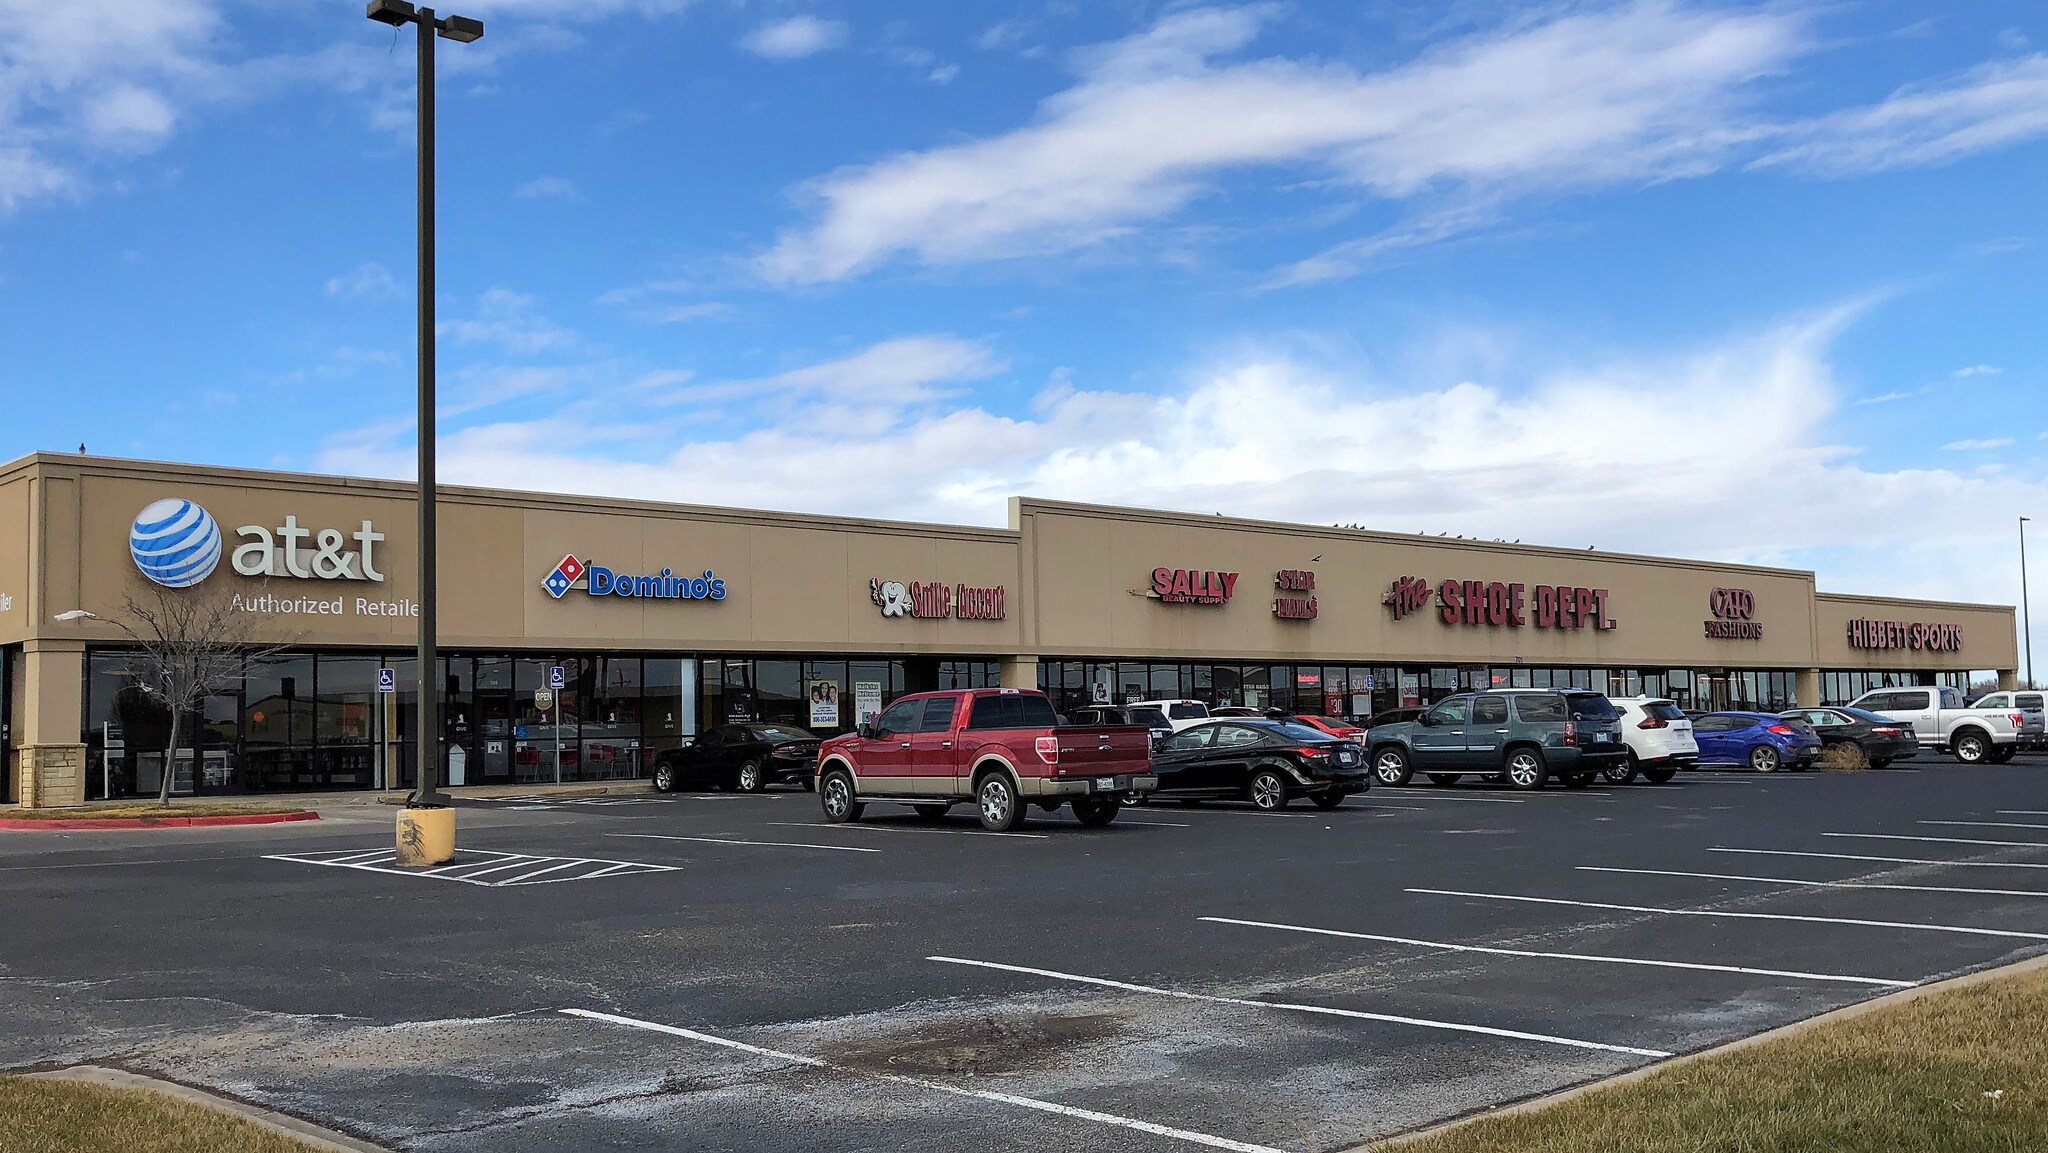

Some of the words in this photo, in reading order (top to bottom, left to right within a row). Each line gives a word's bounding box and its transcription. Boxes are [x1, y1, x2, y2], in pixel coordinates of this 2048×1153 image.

[231, 515, 385, 582] at&t
[588, 566, 727, 600] Domino's
[1152, 567, 1239, 598] SALLY
[1277, 569, 1316, 591] STAR
[230, 593, 343, 615] Authorized
[355, 597, 419, 617] Retaile
[911, 580, 952, 618] Smile
[957, 583, 1007, 620] Accent
[1163, 595, 1195, 604] BEAUTY
[1198, 596, 1230, 605] SUPPLY
[1276, 598, 1318, 619] NAILS
[1388, 576, 1433, 621] the
[1440, 579, 1525, 626] SHOE
[1535, 584, 1617, 630] DEPT.
[1710, 587, 1756, 619] CATO
[1704, 620, 1763, 639] FASHIONS
[1849, 619, 1909, 650] HIBBETT
[1911, 622, 1964, 651] SPORTS
[535, 692, 552, 702] OPEN
